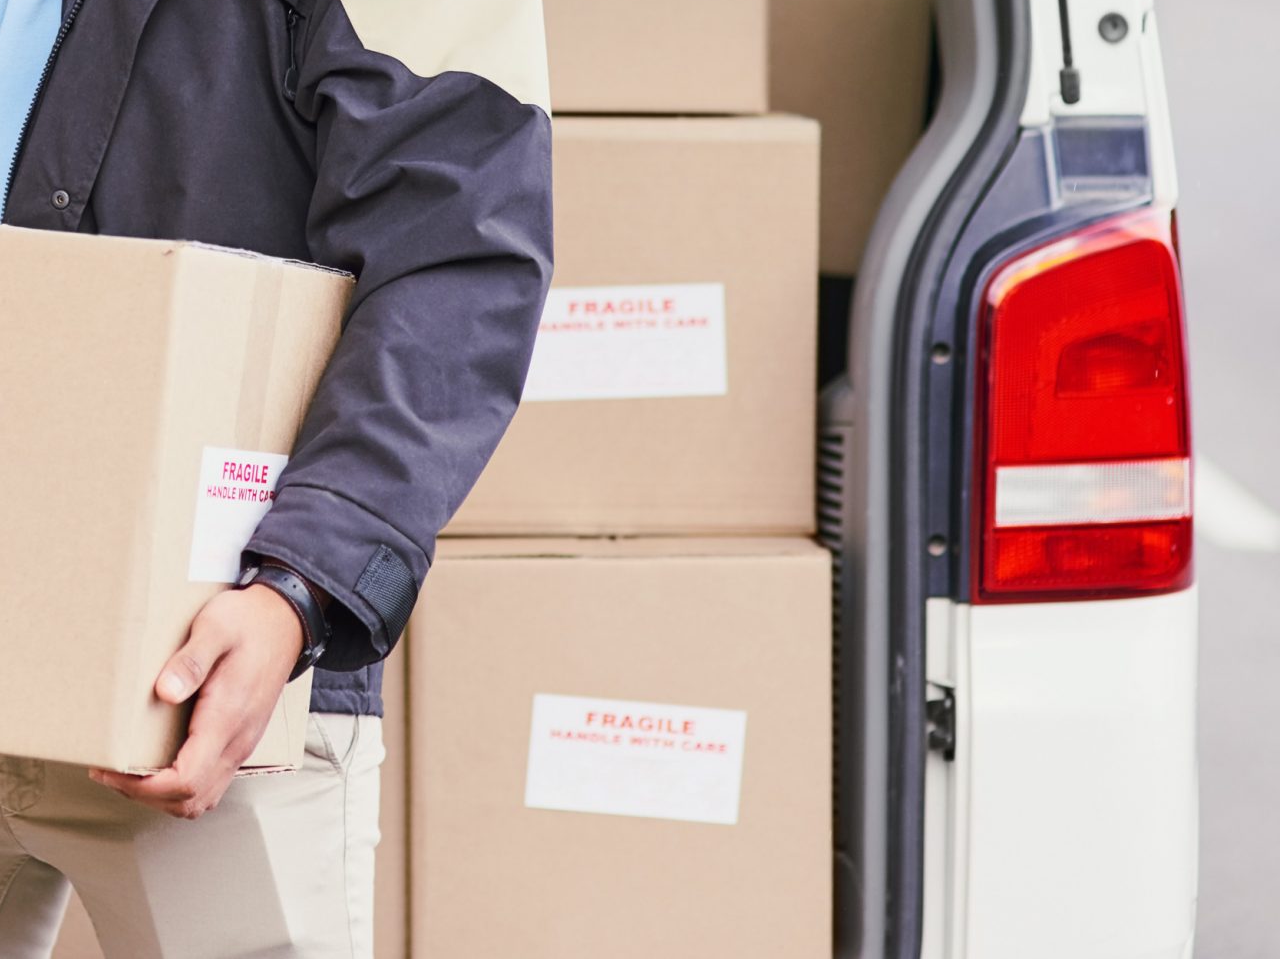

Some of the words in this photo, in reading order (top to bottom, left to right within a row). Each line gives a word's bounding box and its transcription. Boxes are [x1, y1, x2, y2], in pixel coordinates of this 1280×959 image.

[567, 298, 675, 315] FRAGILE
[222, 461, 269, 484] FRAGILE
[206, 485, 237, 500] HANDLE
[238, 487, 258, 502] WITH
[259, 490, 277, 502] CAR
[584, 711, 695, 735] FRAGILE
[551, 730, 622, 745] HANDLE
[629, 736, 674, 749] WITH
[682, 741, 727, 754] CARE
